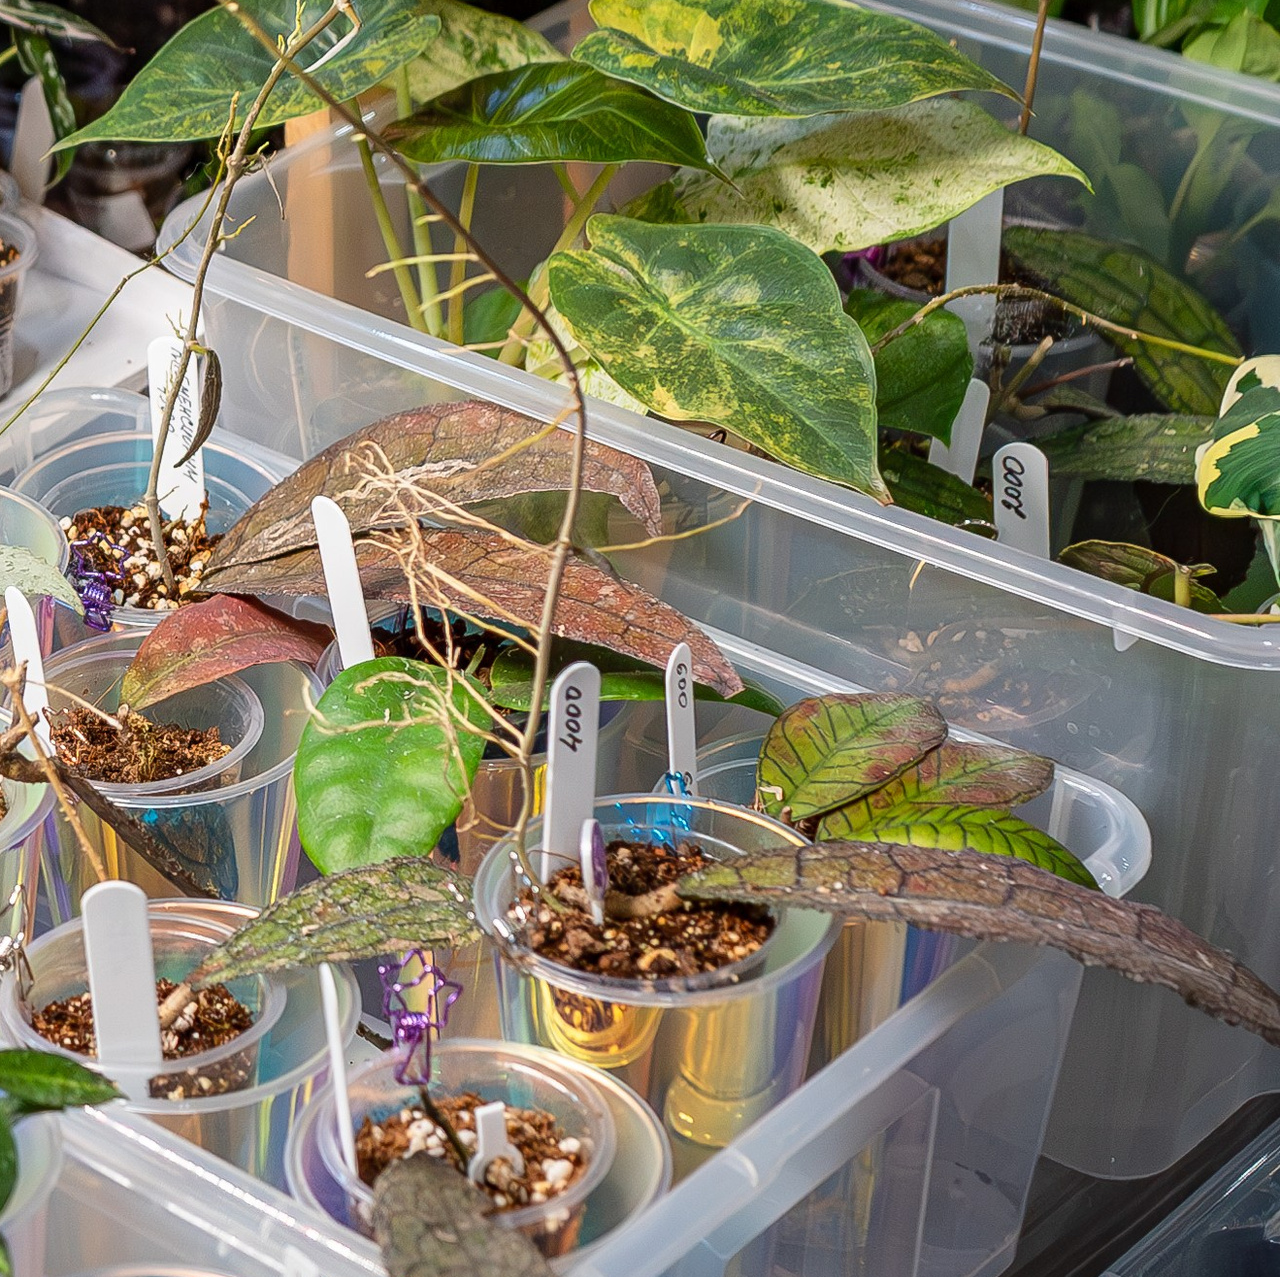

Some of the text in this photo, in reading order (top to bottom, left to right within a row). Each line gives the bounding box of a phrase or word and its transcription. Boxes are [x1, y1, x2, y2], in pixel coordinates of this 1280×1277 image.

[1001, 455, 1027, 520] 2000
[676, 662, 688, 709] 600
[558, 685, 584, 753] 4000
